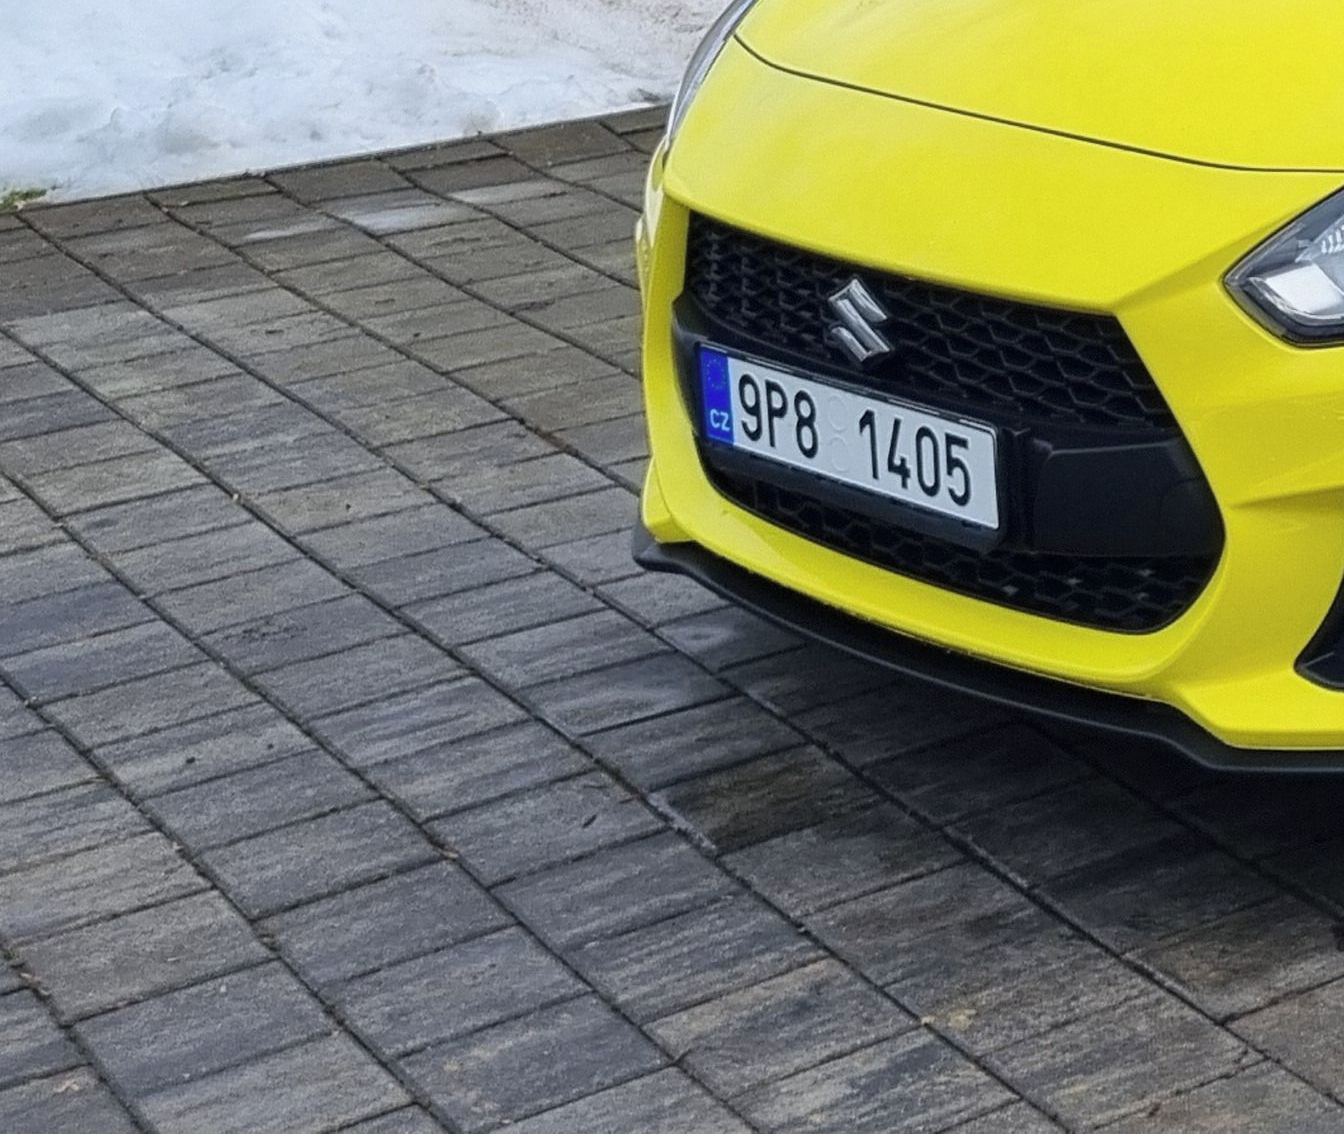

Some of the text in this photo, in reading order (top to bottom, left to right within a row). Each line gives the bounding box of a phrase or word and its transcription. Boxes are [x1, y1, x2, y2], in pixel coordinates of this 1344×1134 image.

[710, 408, 731, 432] CZ
[738, 374, 972, 507] 9P8 1405
